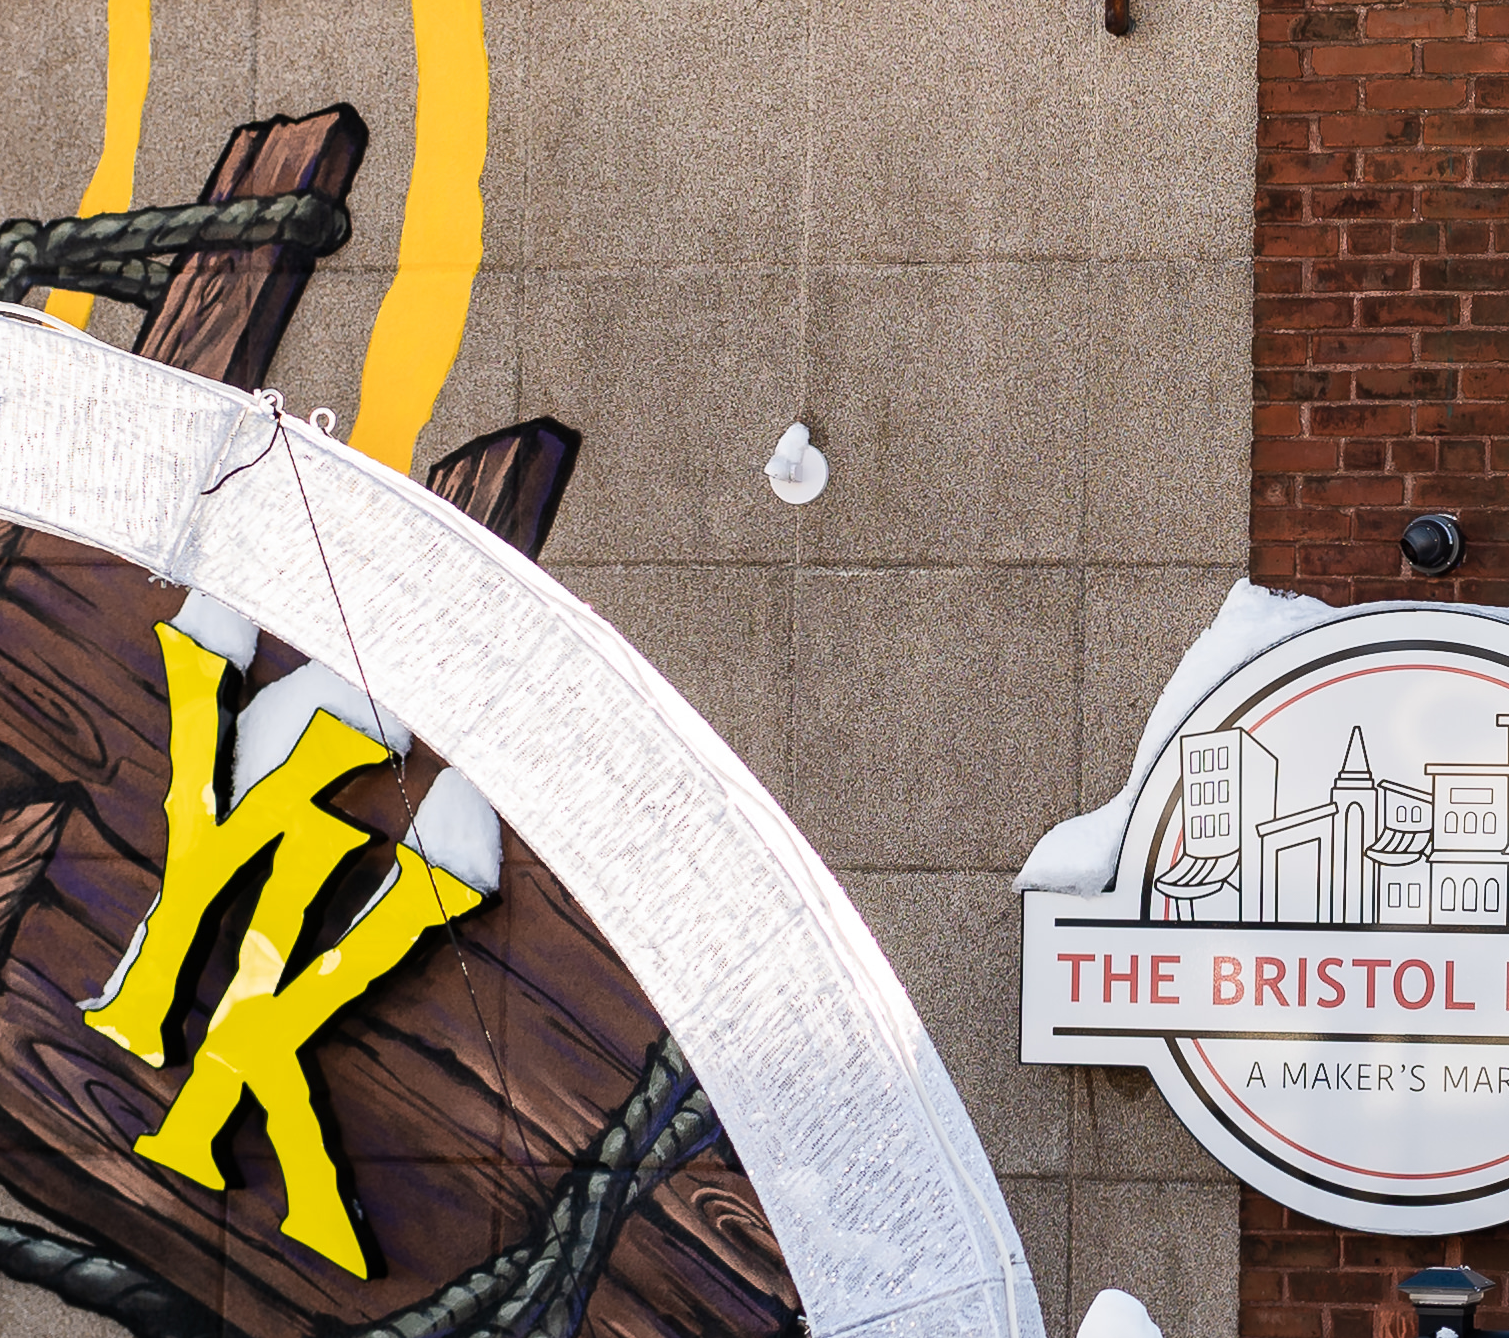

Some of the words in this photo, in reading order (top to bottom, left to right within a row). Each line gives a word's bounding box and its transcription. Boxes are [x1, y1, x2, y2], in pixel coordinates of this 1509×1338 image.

[1057, 952, 1182, 1006] THE
[1211, 955, 1476, 1012] BRISTOL
[1245, 1060, 1267, 1089] A
[1281, 1061, 1428, 1094] MAKER’S
